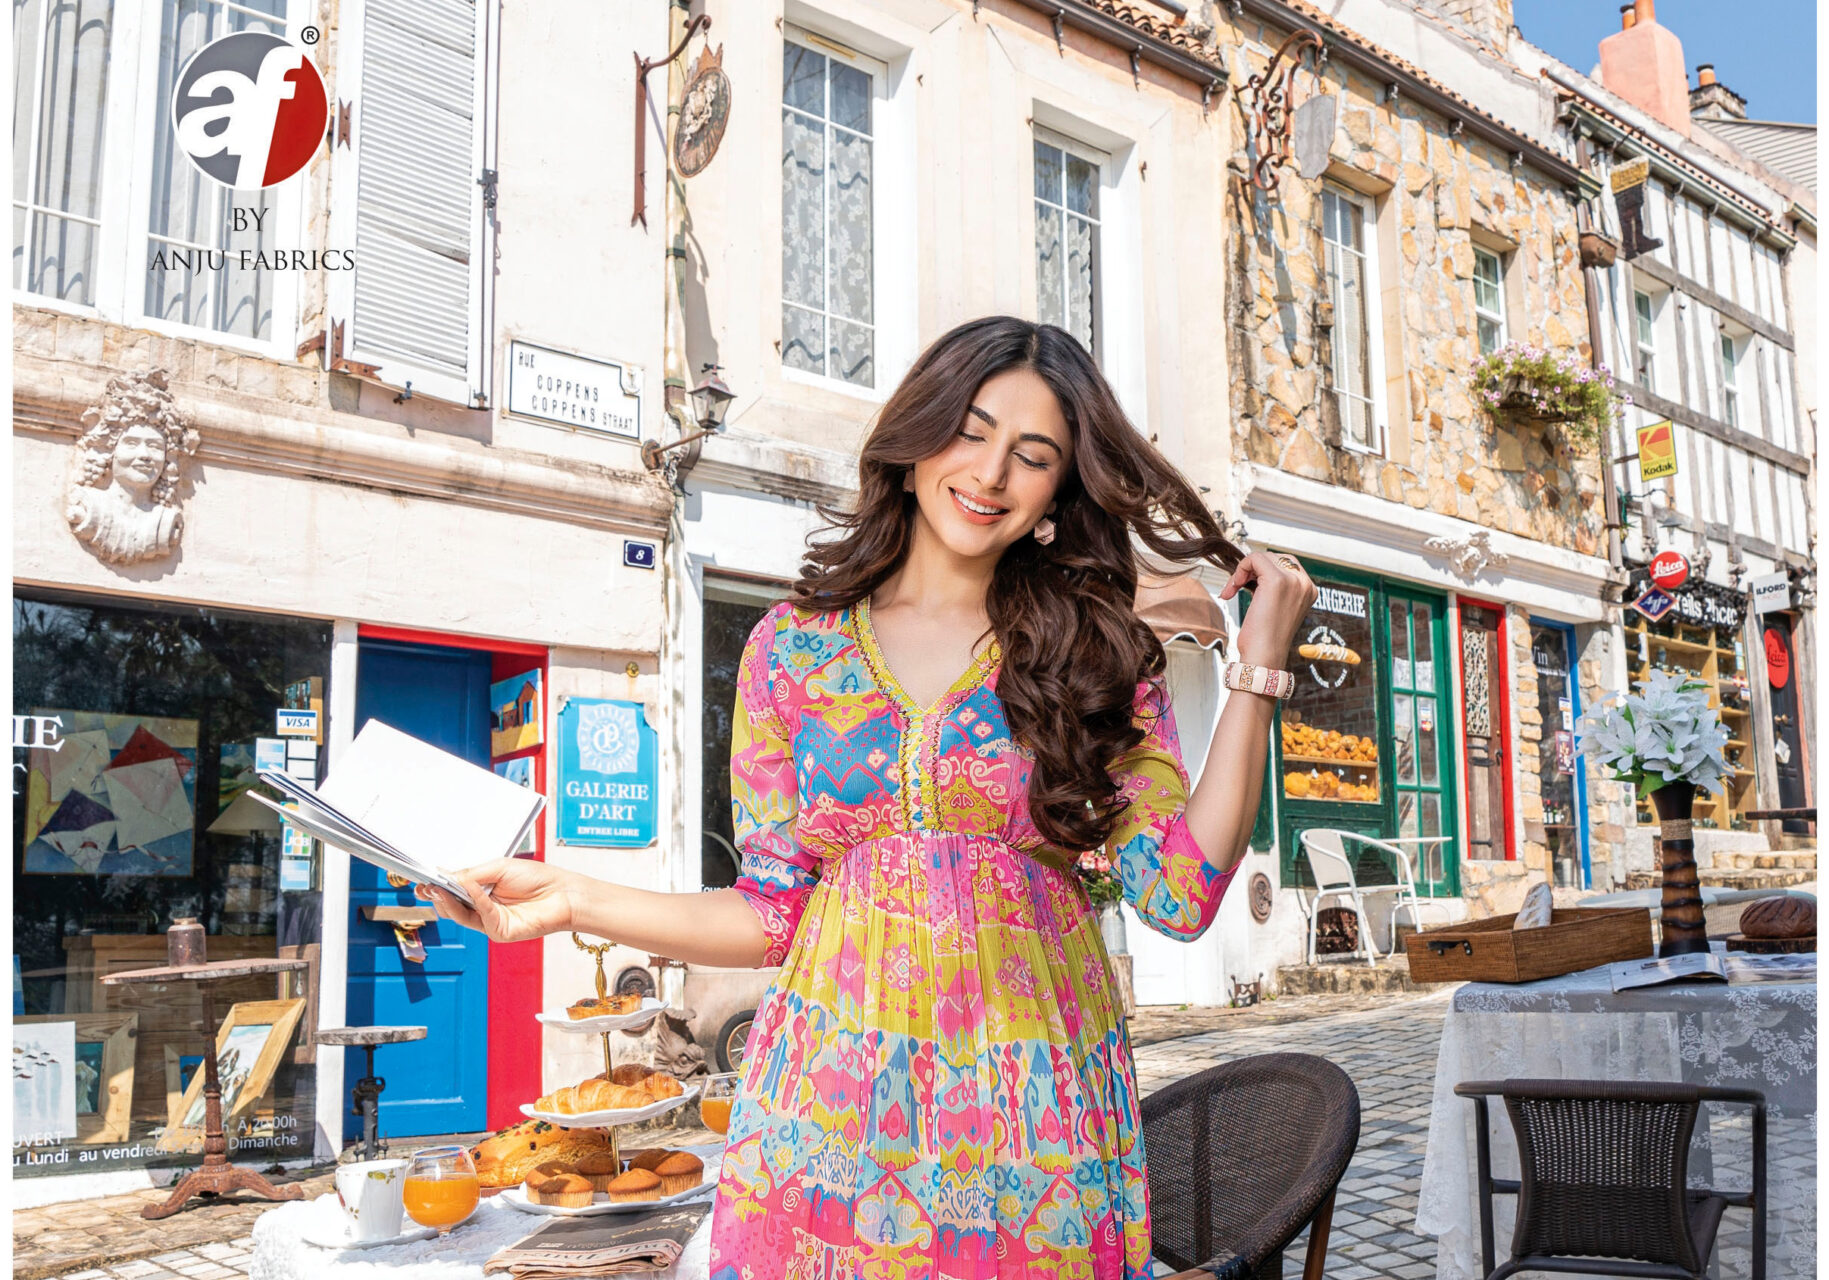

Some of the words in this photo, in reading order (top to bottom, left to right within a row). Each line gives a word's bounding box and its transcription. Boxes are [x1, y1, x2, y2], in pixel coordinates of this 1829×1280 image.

[518, 351, 536, 369] RUE
[536, 374, 599, 402] COPPENS
[531, 395, 597, 423] COPPENS
[602, 412, 634, 430] STRAAT
[1643, 461, 1674, 477] Kodak
[635, 549, 646, 561] 8
[1652, 558, 1686, 579] Leica
[1756, 583, 1786, 596] ILFORD
[286, 717, 310, 728] VISA
[566, 780, 649, 801] GALERIE
[578, 803, 637, 821] D'ART
[26, 1148, 69, 1165] Lundi
[79, 1150, 98, 1162] au
[102, 1142, 168, 1160] vendredi
[229, 1132, 298, 1150] Dimanche
